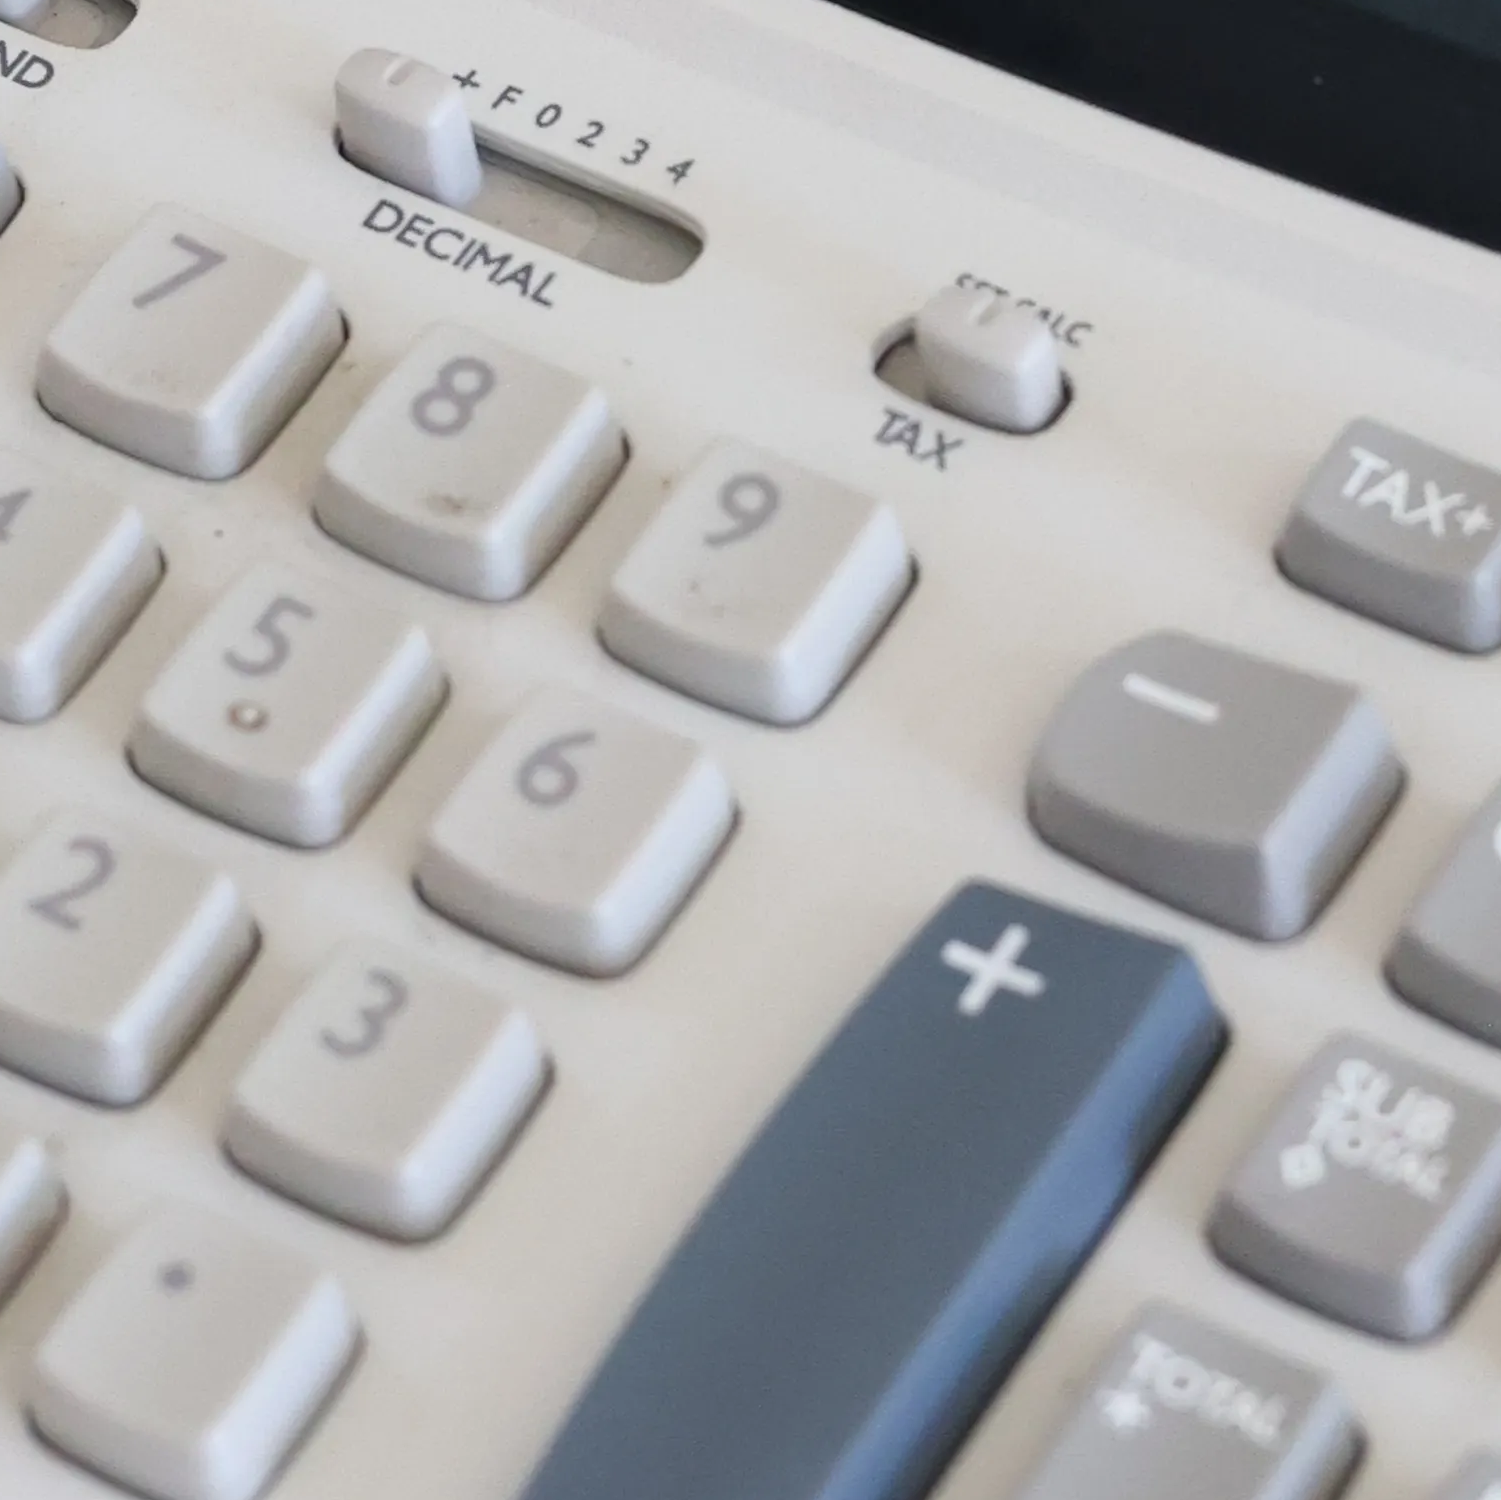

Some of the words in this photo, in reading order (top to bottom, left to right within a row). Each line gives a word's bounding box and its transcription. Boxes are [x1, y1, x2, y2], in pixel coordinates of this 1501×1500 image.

[491, 85, 523, 109] F
[535, 103, 562, 128] 0
[576, 120, 604, 148] 2
[621, 138, 650, 165] 3
[666, 160, 693, 184] 4
[132, 234, 227, 309] 7
[362, 197, 558, 307] DECIMAL
[412, 357, 496, 437] 8
[873, 409, 965, 474] TAX
[705, 474, 780, 547] 9
[1342, 447, 1493, 537] TAX+
[225, 596, 314, 677] 5
[517, 732, 595, 808] 6
[29, 839, 117, 931] 2
[322, 971, 408, 1058] 3
